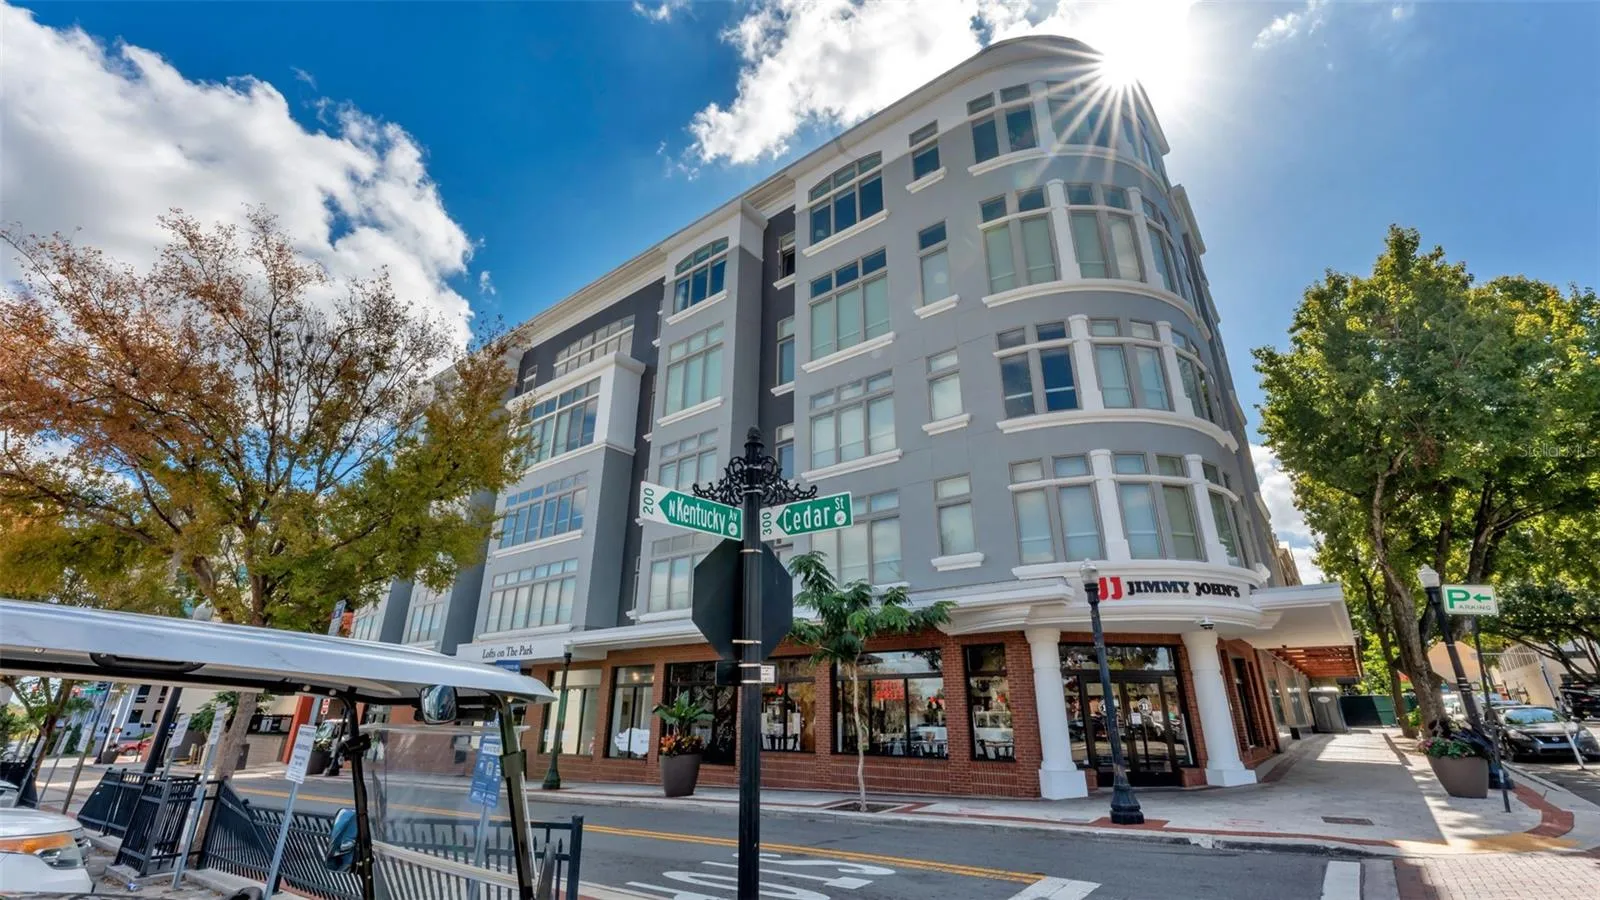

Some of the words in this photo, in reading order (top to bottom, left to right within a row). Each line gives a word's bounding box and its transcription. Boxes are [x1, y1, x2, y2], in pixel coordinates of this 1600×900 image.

[643, 487, 655, 515] 200
[668, 499, 676, 518] N
[676, 496, 726, 535] Kentucky
[729, 509, 738, 522] Av
[762, 512, 772, 535] 300
[783, 505, 831, 532] Cedar
[834, 497, 845, 510] St
[1098, 576, 1123, 600] JJ
[1127, 580, 1190, 596] JIMMY
[1194, 581, 1241, 598] JOHN'S
[506, 646, 518, 656] The
[519, 644, 534, 655] Park
